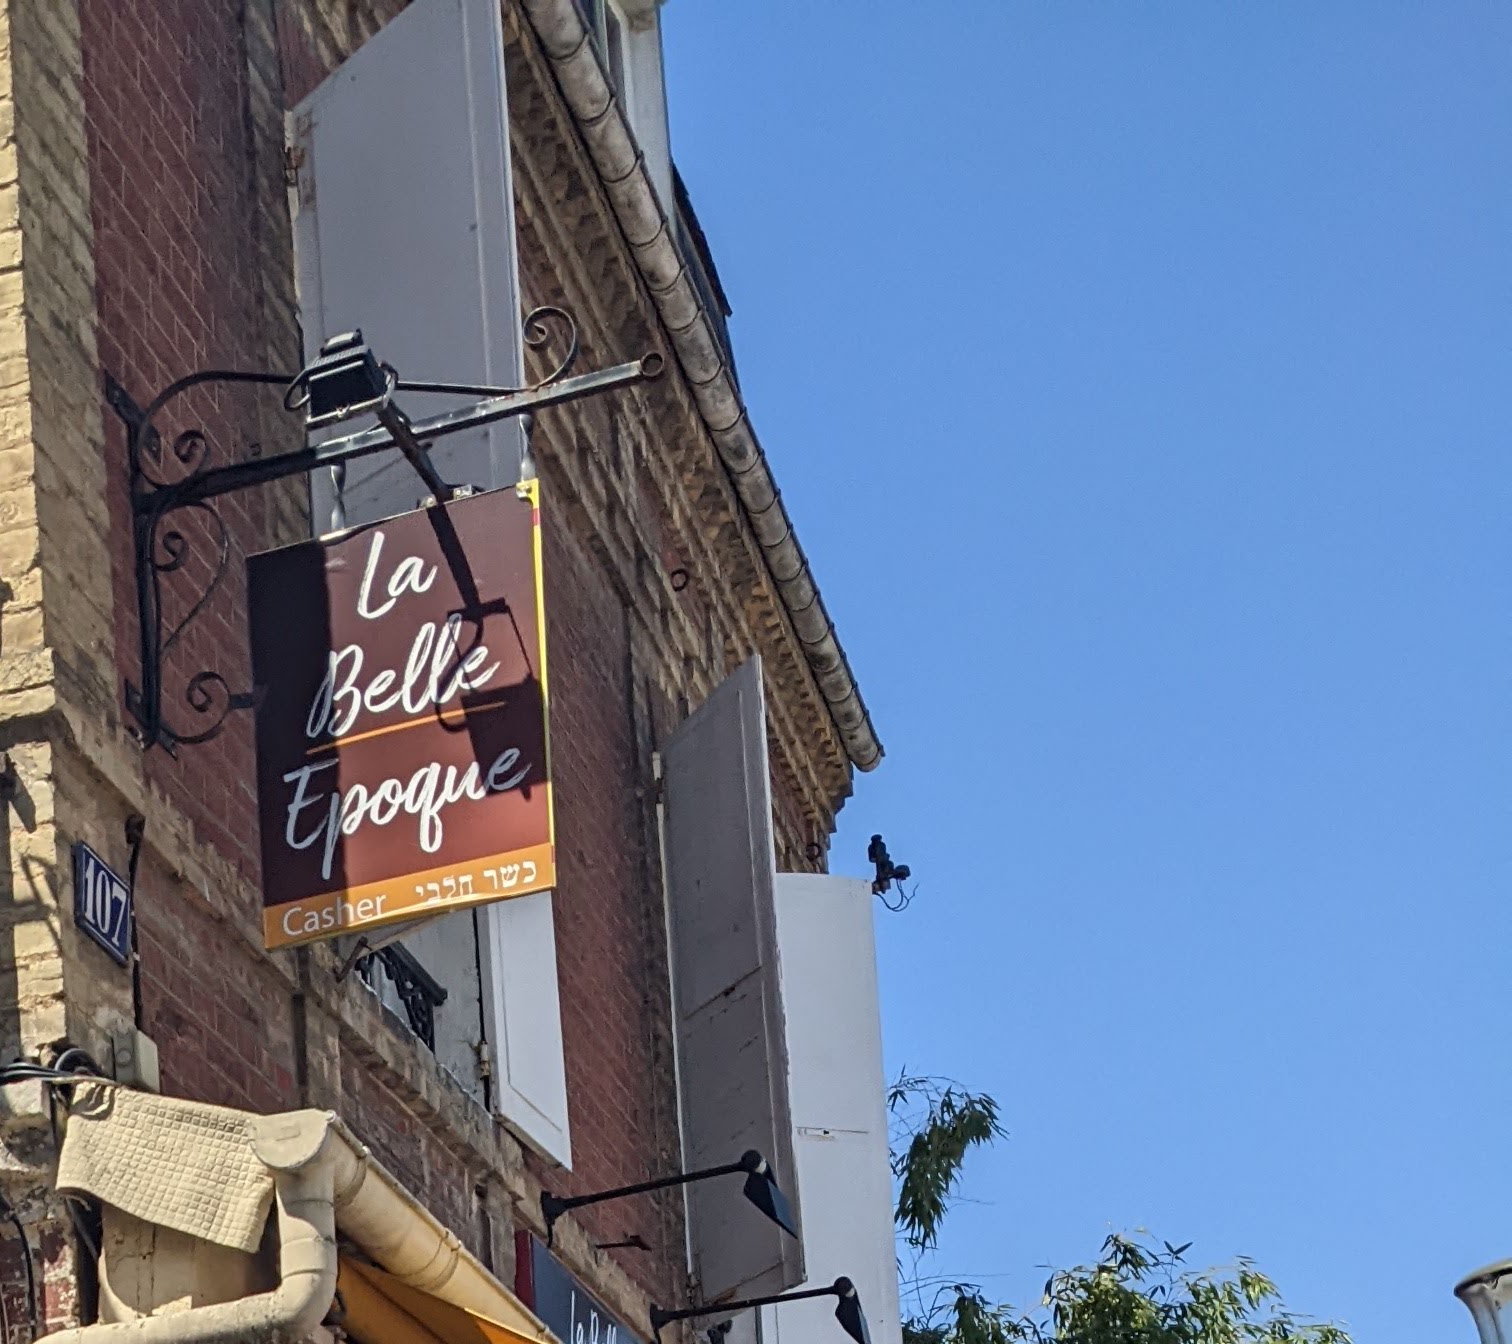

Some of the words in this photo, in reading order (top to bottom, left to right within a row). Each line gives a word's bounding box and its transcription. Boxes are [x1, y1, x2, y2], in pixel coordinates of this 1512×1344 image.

[357, 531, 437, 619] La
[306, 614, 501, 738] Belle
[282, 747, 531, 880] Epoque
[85, 861, 128, 945] 107
[283, 893, 386, 936] Casher
[415, 874, 473, 905] חלבי
[483, 860, 536, 890] כשר
